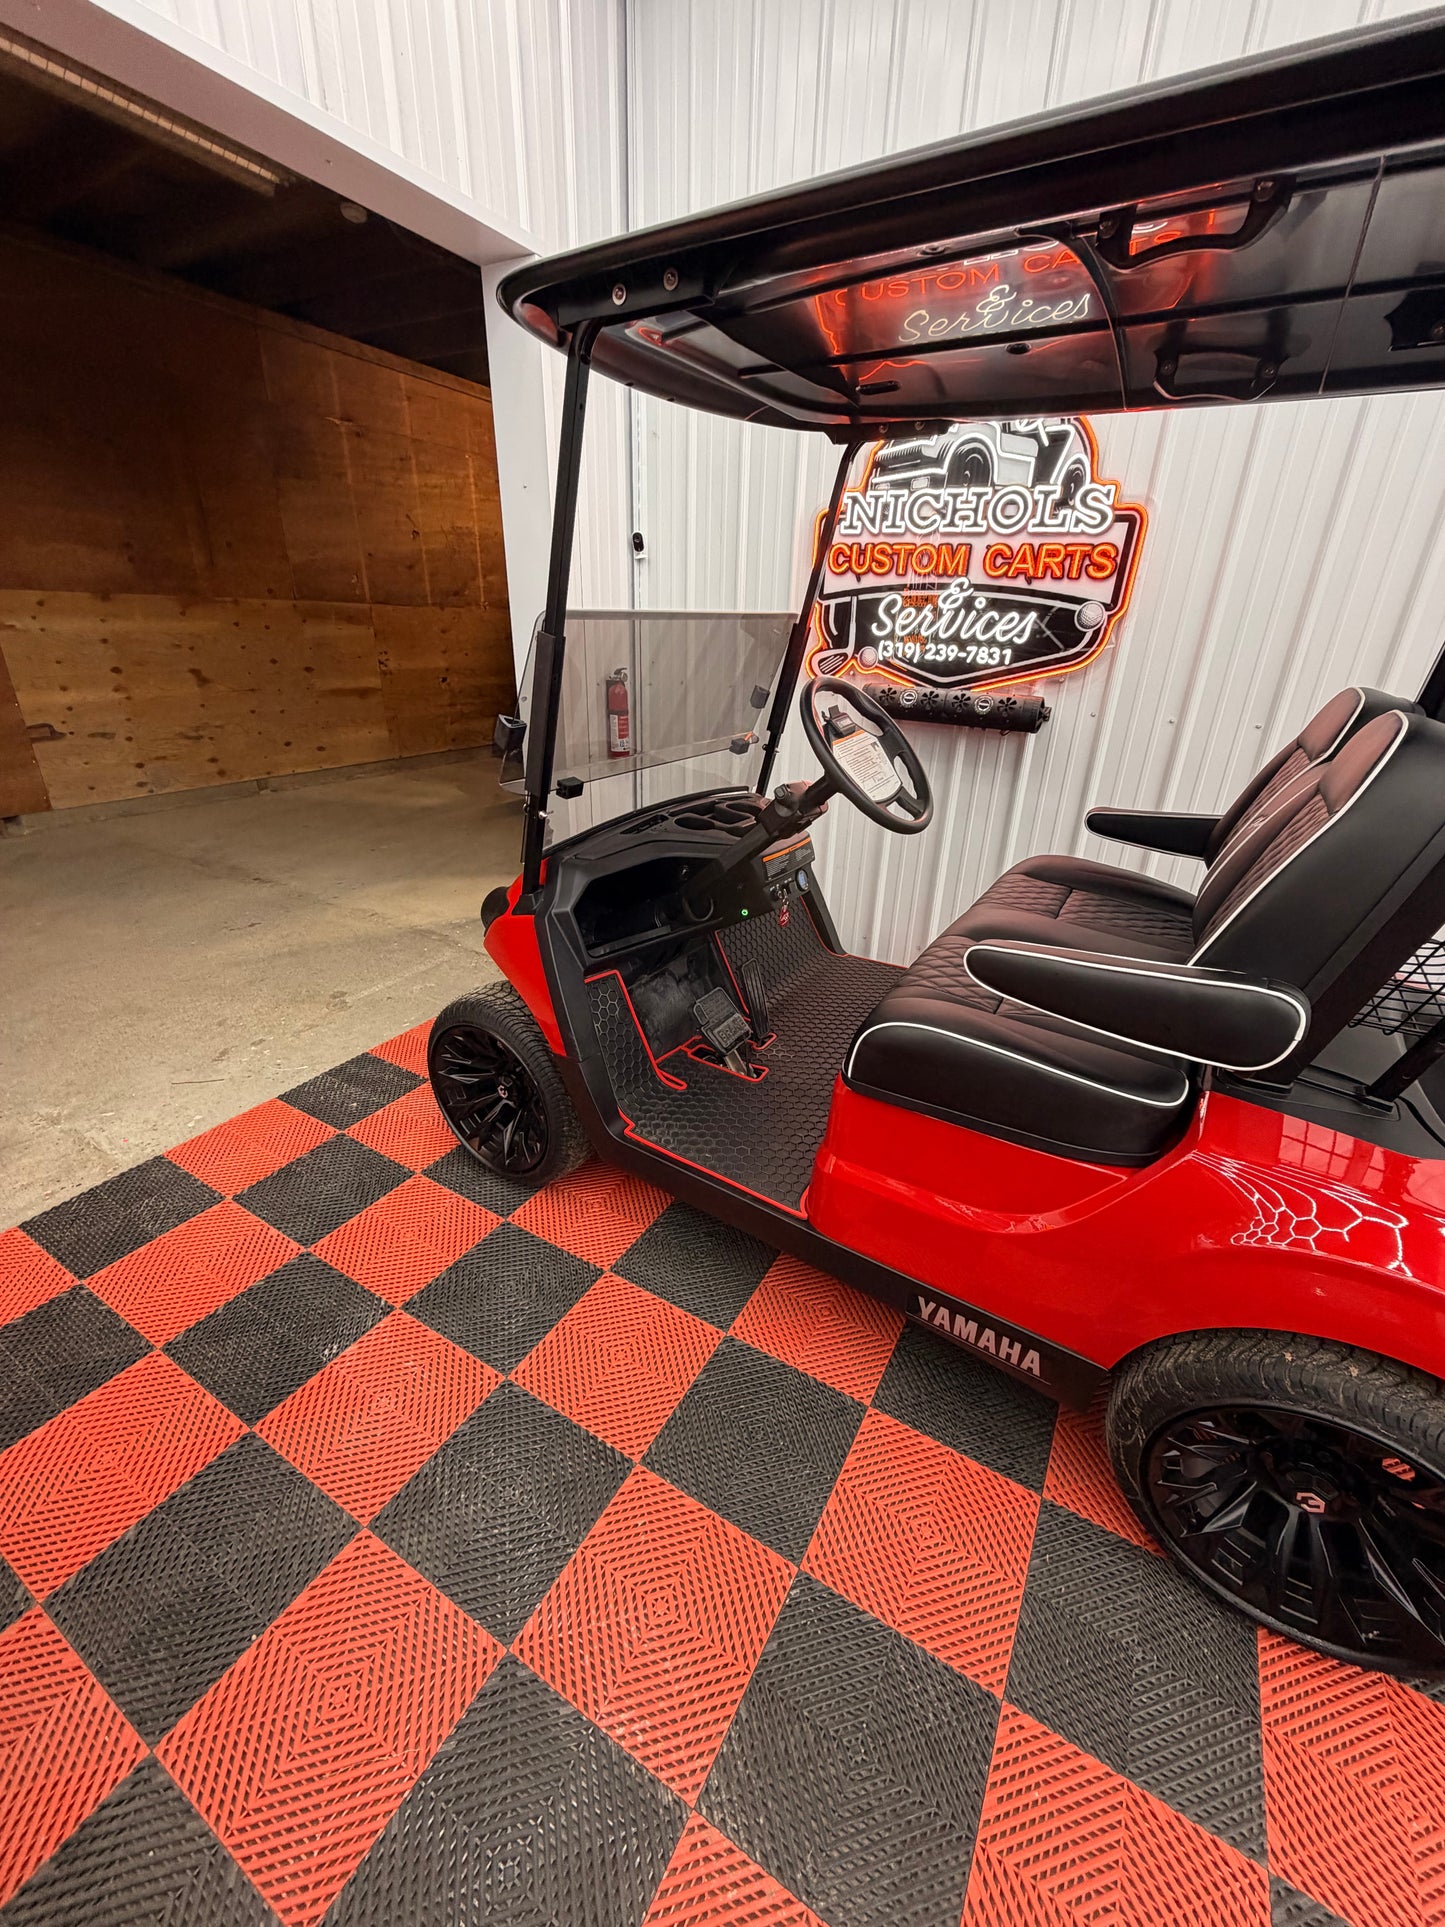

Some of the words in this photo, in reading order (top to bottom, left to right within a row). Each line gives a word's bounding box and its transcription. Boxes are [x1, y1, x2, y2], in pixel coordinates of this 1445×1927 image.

[899, 293, 1091, 342] Services
[839, 484, 1116, 535] NICHOLS
[828, 542, 973, 577] CUSTOM
[983, 542, 1118, 579] CARTS
[938, 577, 974, 609] &
[871, 593, 1038, 645] Services
[878, 640, 921, 663] (319)
[924, 643, 1012, 665] 239-7831
[918, 1296, 1041, 1377] YAMAHA
